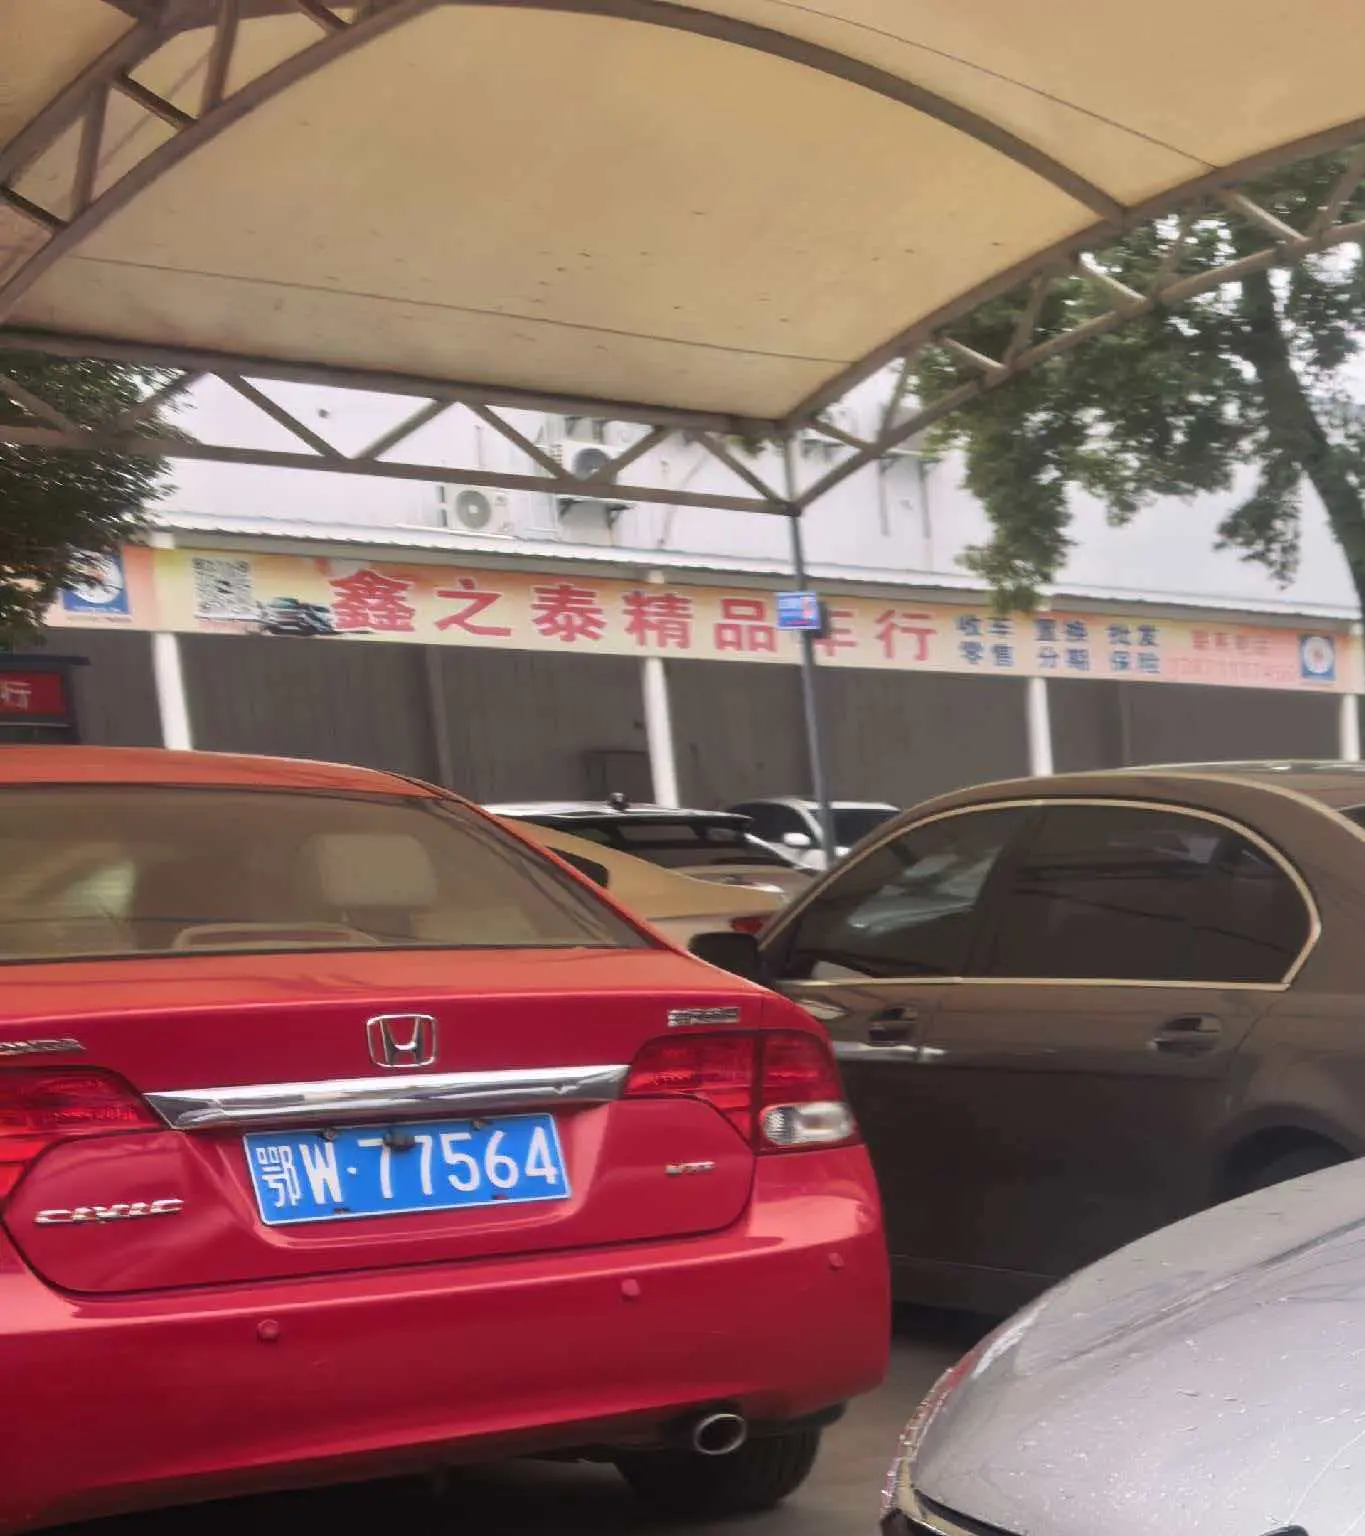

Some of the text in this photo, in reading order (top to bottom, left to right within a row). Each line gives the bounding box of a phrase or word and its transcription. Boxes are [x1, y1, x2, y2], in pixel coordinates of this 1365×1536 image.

[331, 568, 938, 661] 鑫之泰精品车行
